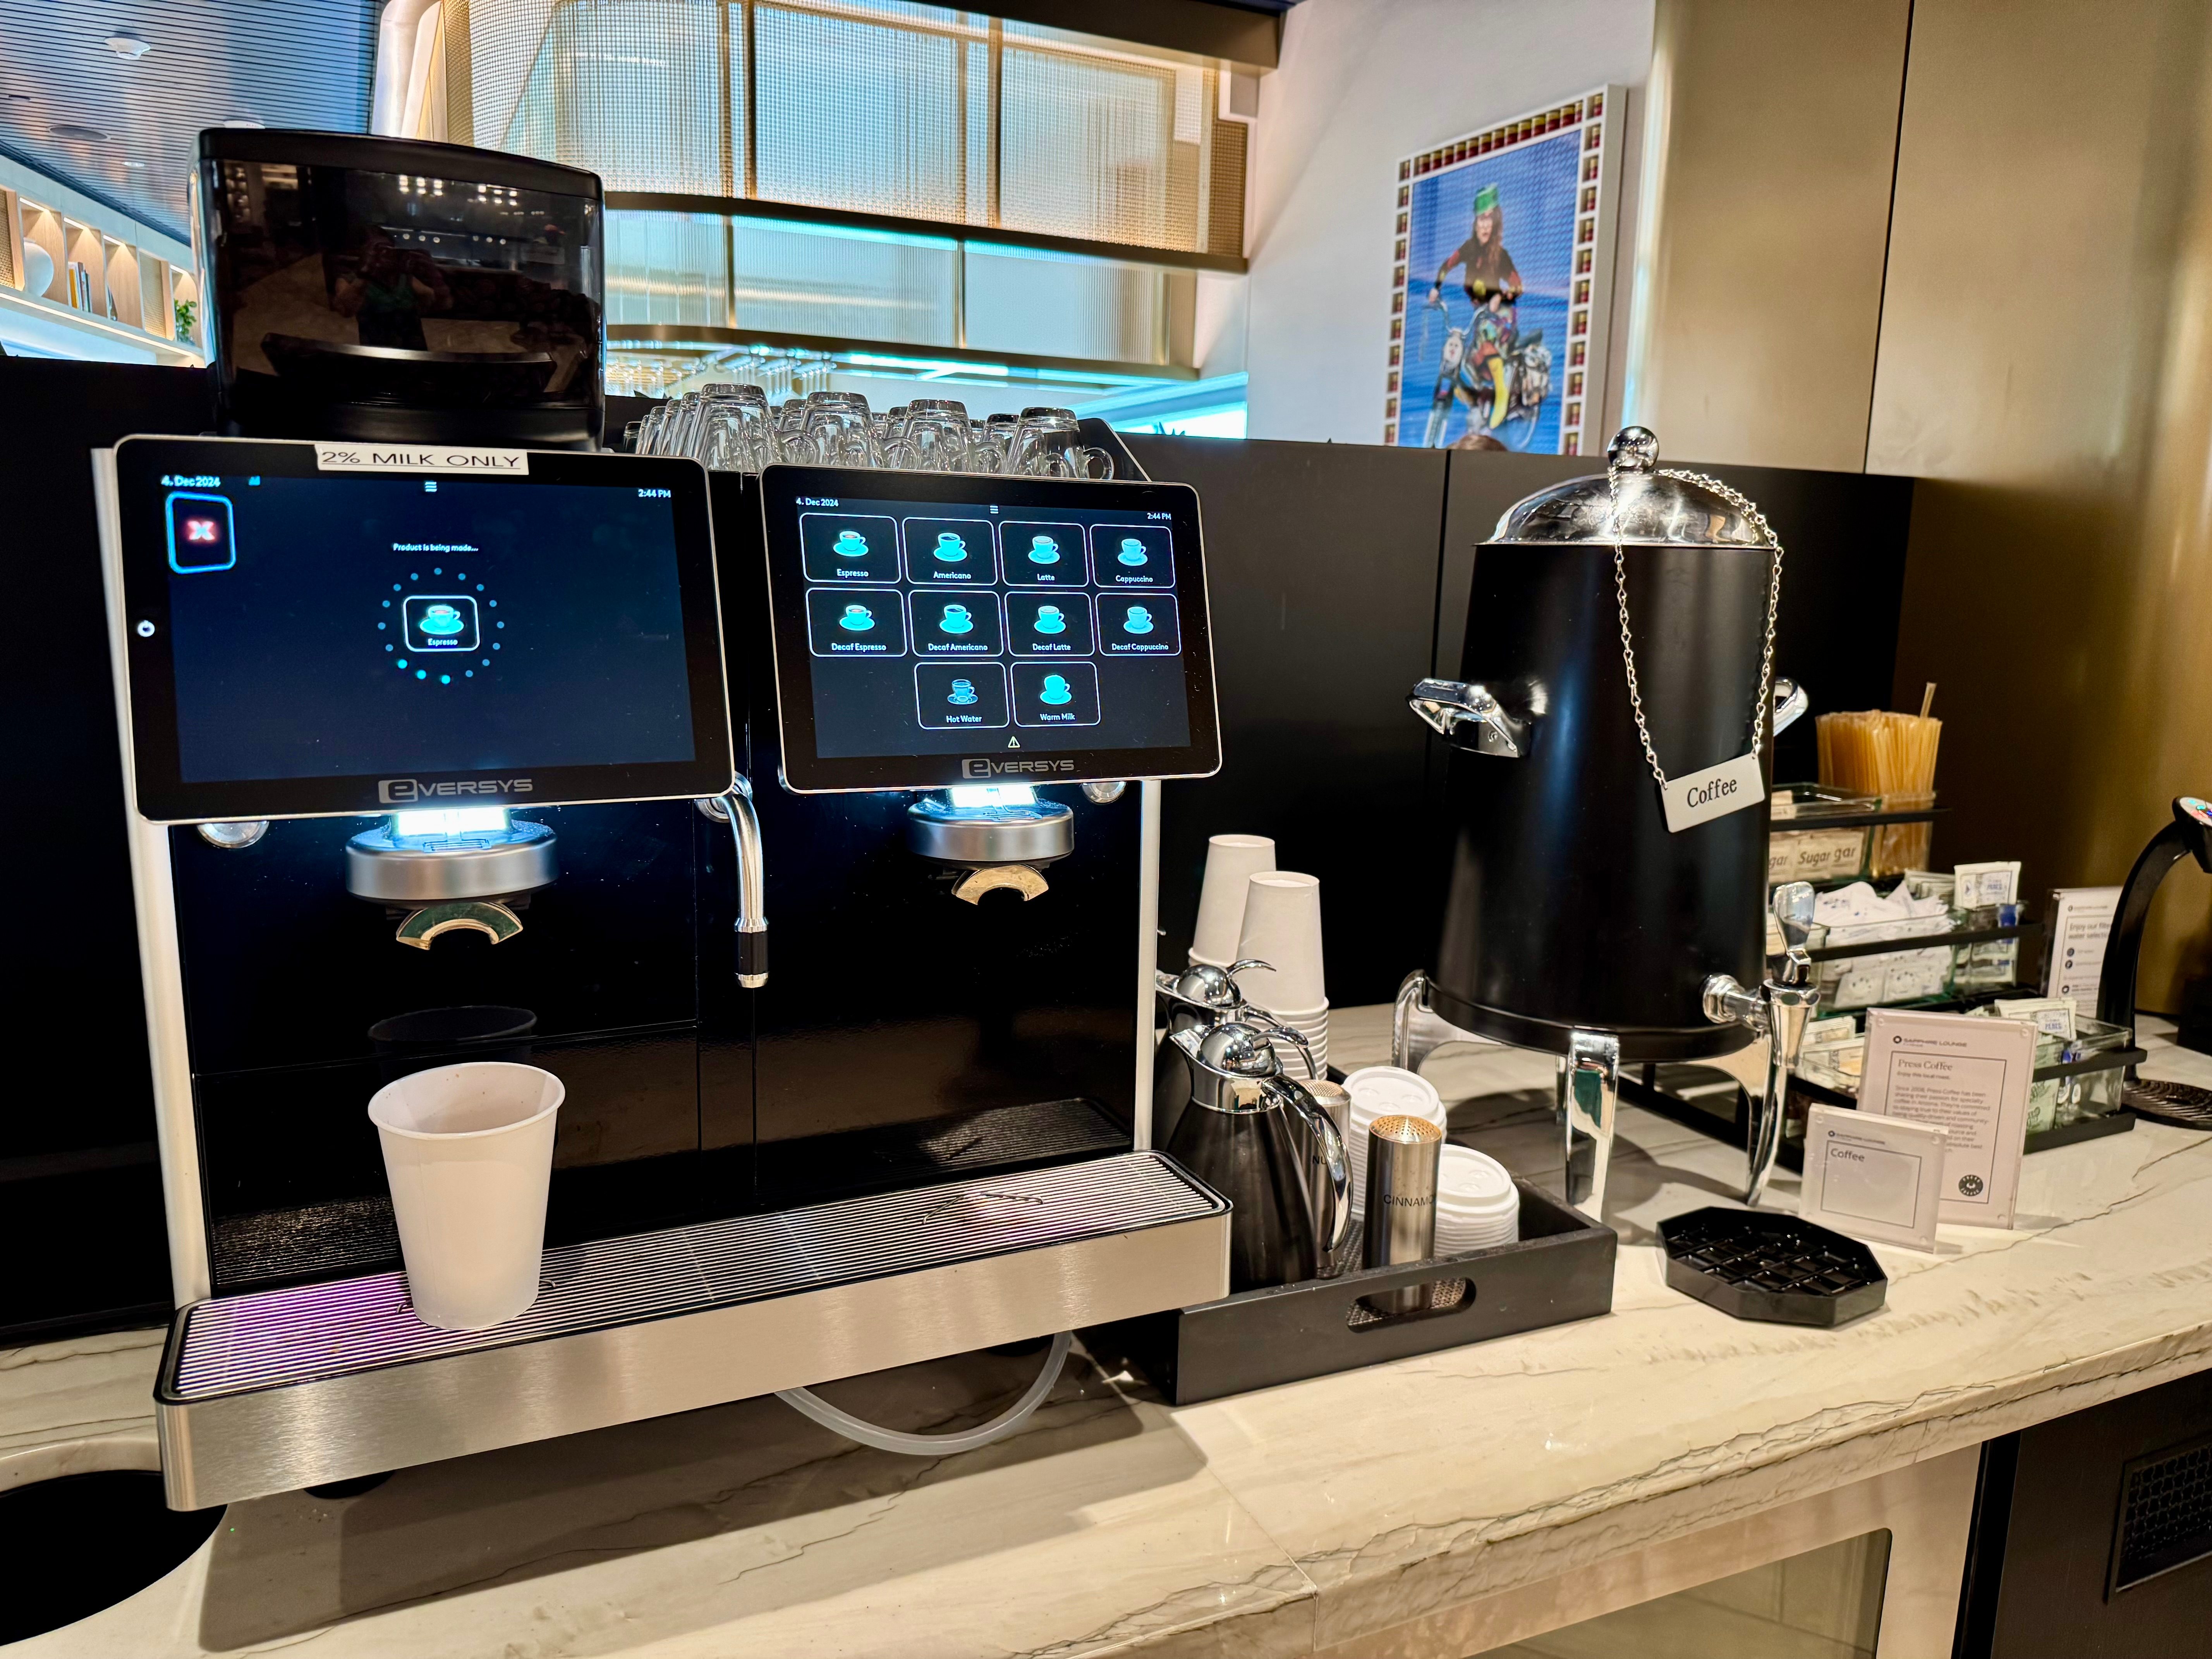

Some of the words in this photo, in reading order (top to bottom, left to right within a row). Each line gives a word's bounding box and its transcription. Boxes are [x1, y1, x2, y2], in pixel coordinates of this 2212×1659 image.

[321, 451, 361, 464] 2%
[373, 452, 434, 465] MILK
[447, 454, 520, 467] ONLY
[161, 475, 174, 487] 4.
[175, 476, 195, 487] Dec
[196, 477, 221, 487] 2024
[638, 488, 657, 498] 2:44
[658, 489, 672, 499] PM
[805, 498, 820, 507] Dec
[821, 499, 839, 507] 2024
[393, 543, 422, 551] Product
[430, 544, 450, 553] being
[836, 569, 869, 578] Espresso
[933, 571, 972, 580] Americano
[1037, 574, 1055, 582] Latte
[1116, 575, 1153, 584] Cappuccino
[428, 638, 458, 647] Espresso
[928, 643, 950, 651] Decaf
[950, 644, 988, 652] Americano
[1112, 643, 1130, 651] Decaf
[1131, 644, 1169, 652] Cappuccino
[831, 643, 854, 651] Decaf
[855, 643, 887, 653] Espresso
[1687, 779, 1737, 807] Coffee
[1798, 851, 1831, 867] Sugar
[1898, 1059, 1922, 1068] Press
[1923, 1061, 1953, 1071] Coffee
[1831, 1148, 1865, 1162] Coffee
